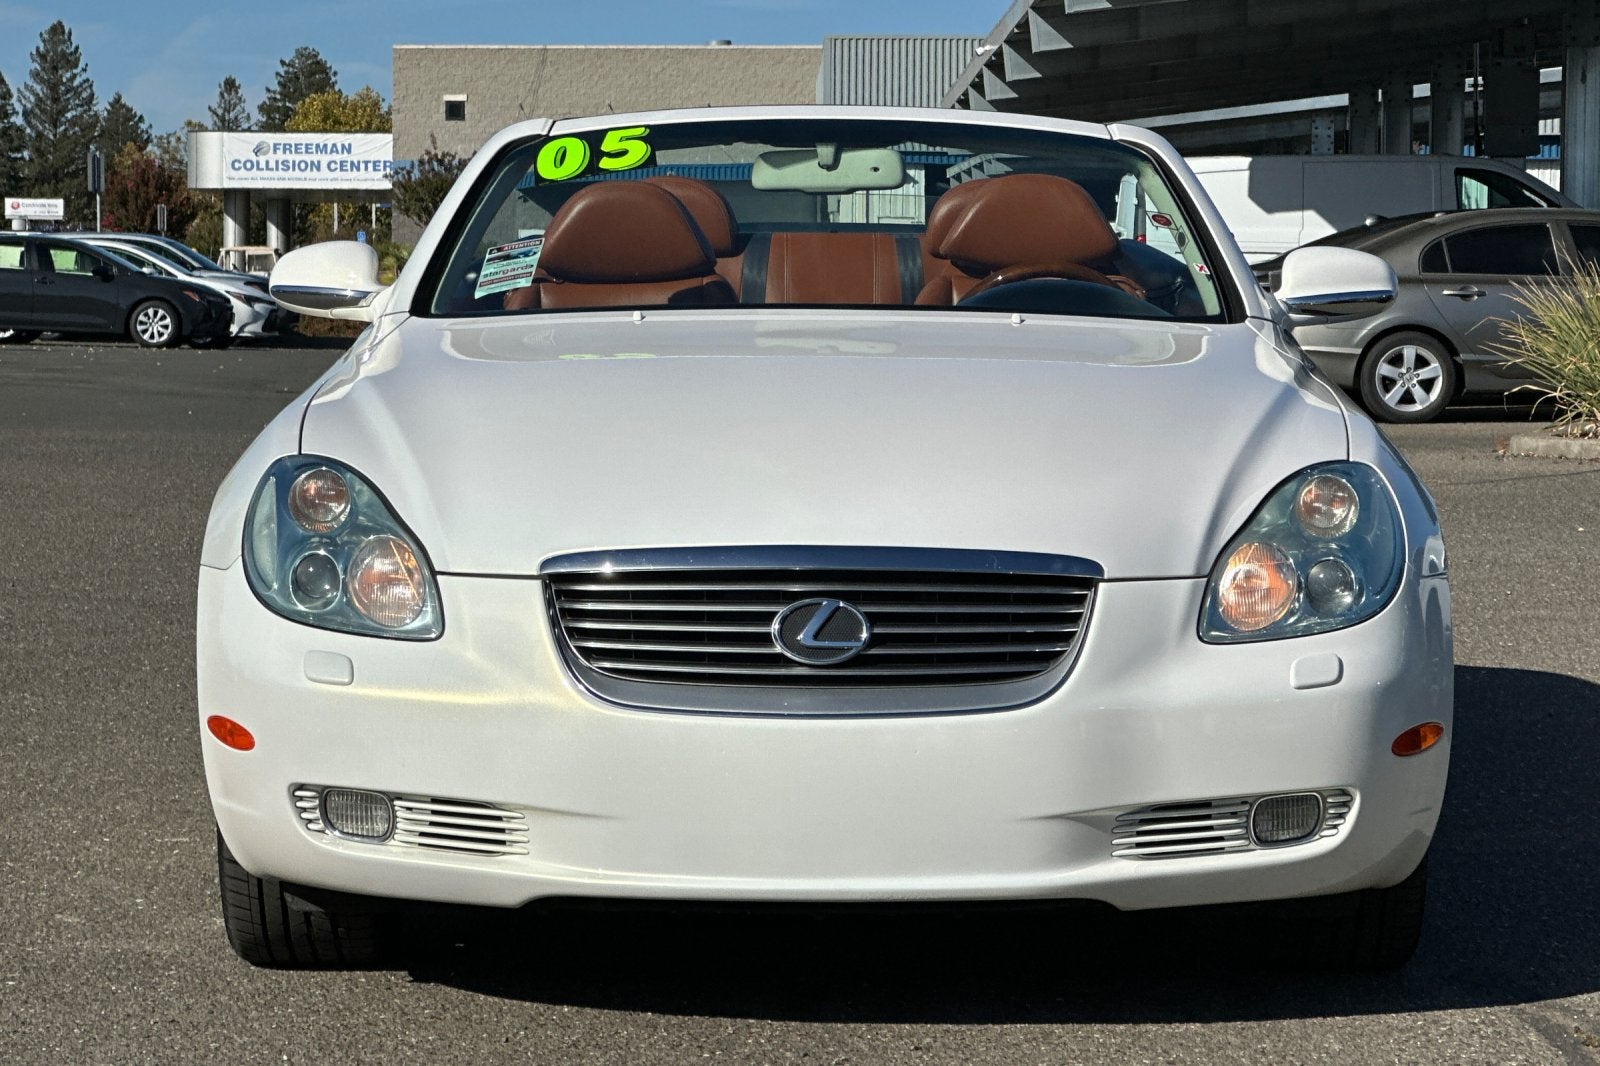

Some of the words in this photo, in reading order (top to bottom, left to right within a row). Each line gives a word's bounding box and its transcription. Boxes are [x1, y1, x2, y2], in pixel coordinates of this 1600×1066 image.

[272, 142, 352, 155] FREEMAN
[536, 127, 652, 181] 05
[230, 159, 321, 172] COLLISION
[326, 160, 395, 173] CENTER
[503, 240, 541, 251] ATTENTION
